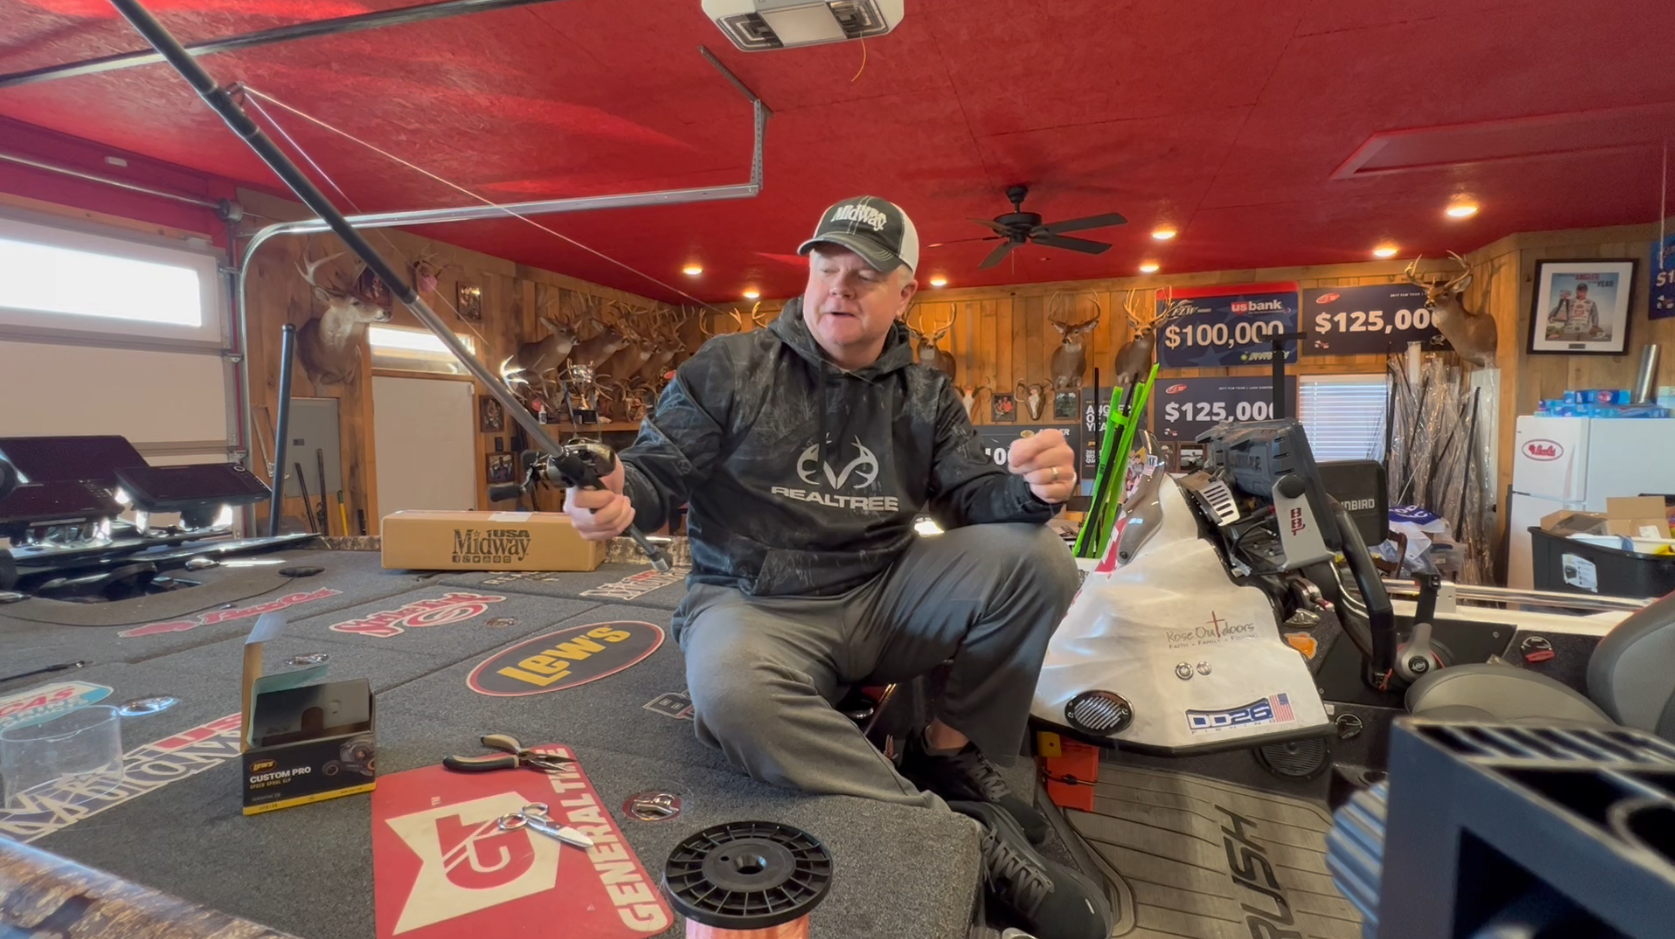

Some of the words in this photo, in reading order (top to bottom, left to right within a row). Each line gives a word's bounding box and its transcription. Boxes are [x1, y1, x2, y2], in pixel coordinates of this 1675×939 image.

[830, 204, 887, 231] Midway
[1165, 401, 1274, 423] $125,00
[771, 486, 899, 512] REALTREE
[1341, 498, 1375, 511] NBIRD
[452, 529, 531, 562] Midway
[493, 529, 530, 538] USA
[1166, 631, 1193, 642] Rose
[1195, 610, 1254, 639] Outdoors
[0, 687, 76, 717] CAS
[249, 770, 291, 784] CUSTOM
[292, 766, 312, 776] PRO
[560, 793, 669, 933] GENERAL
